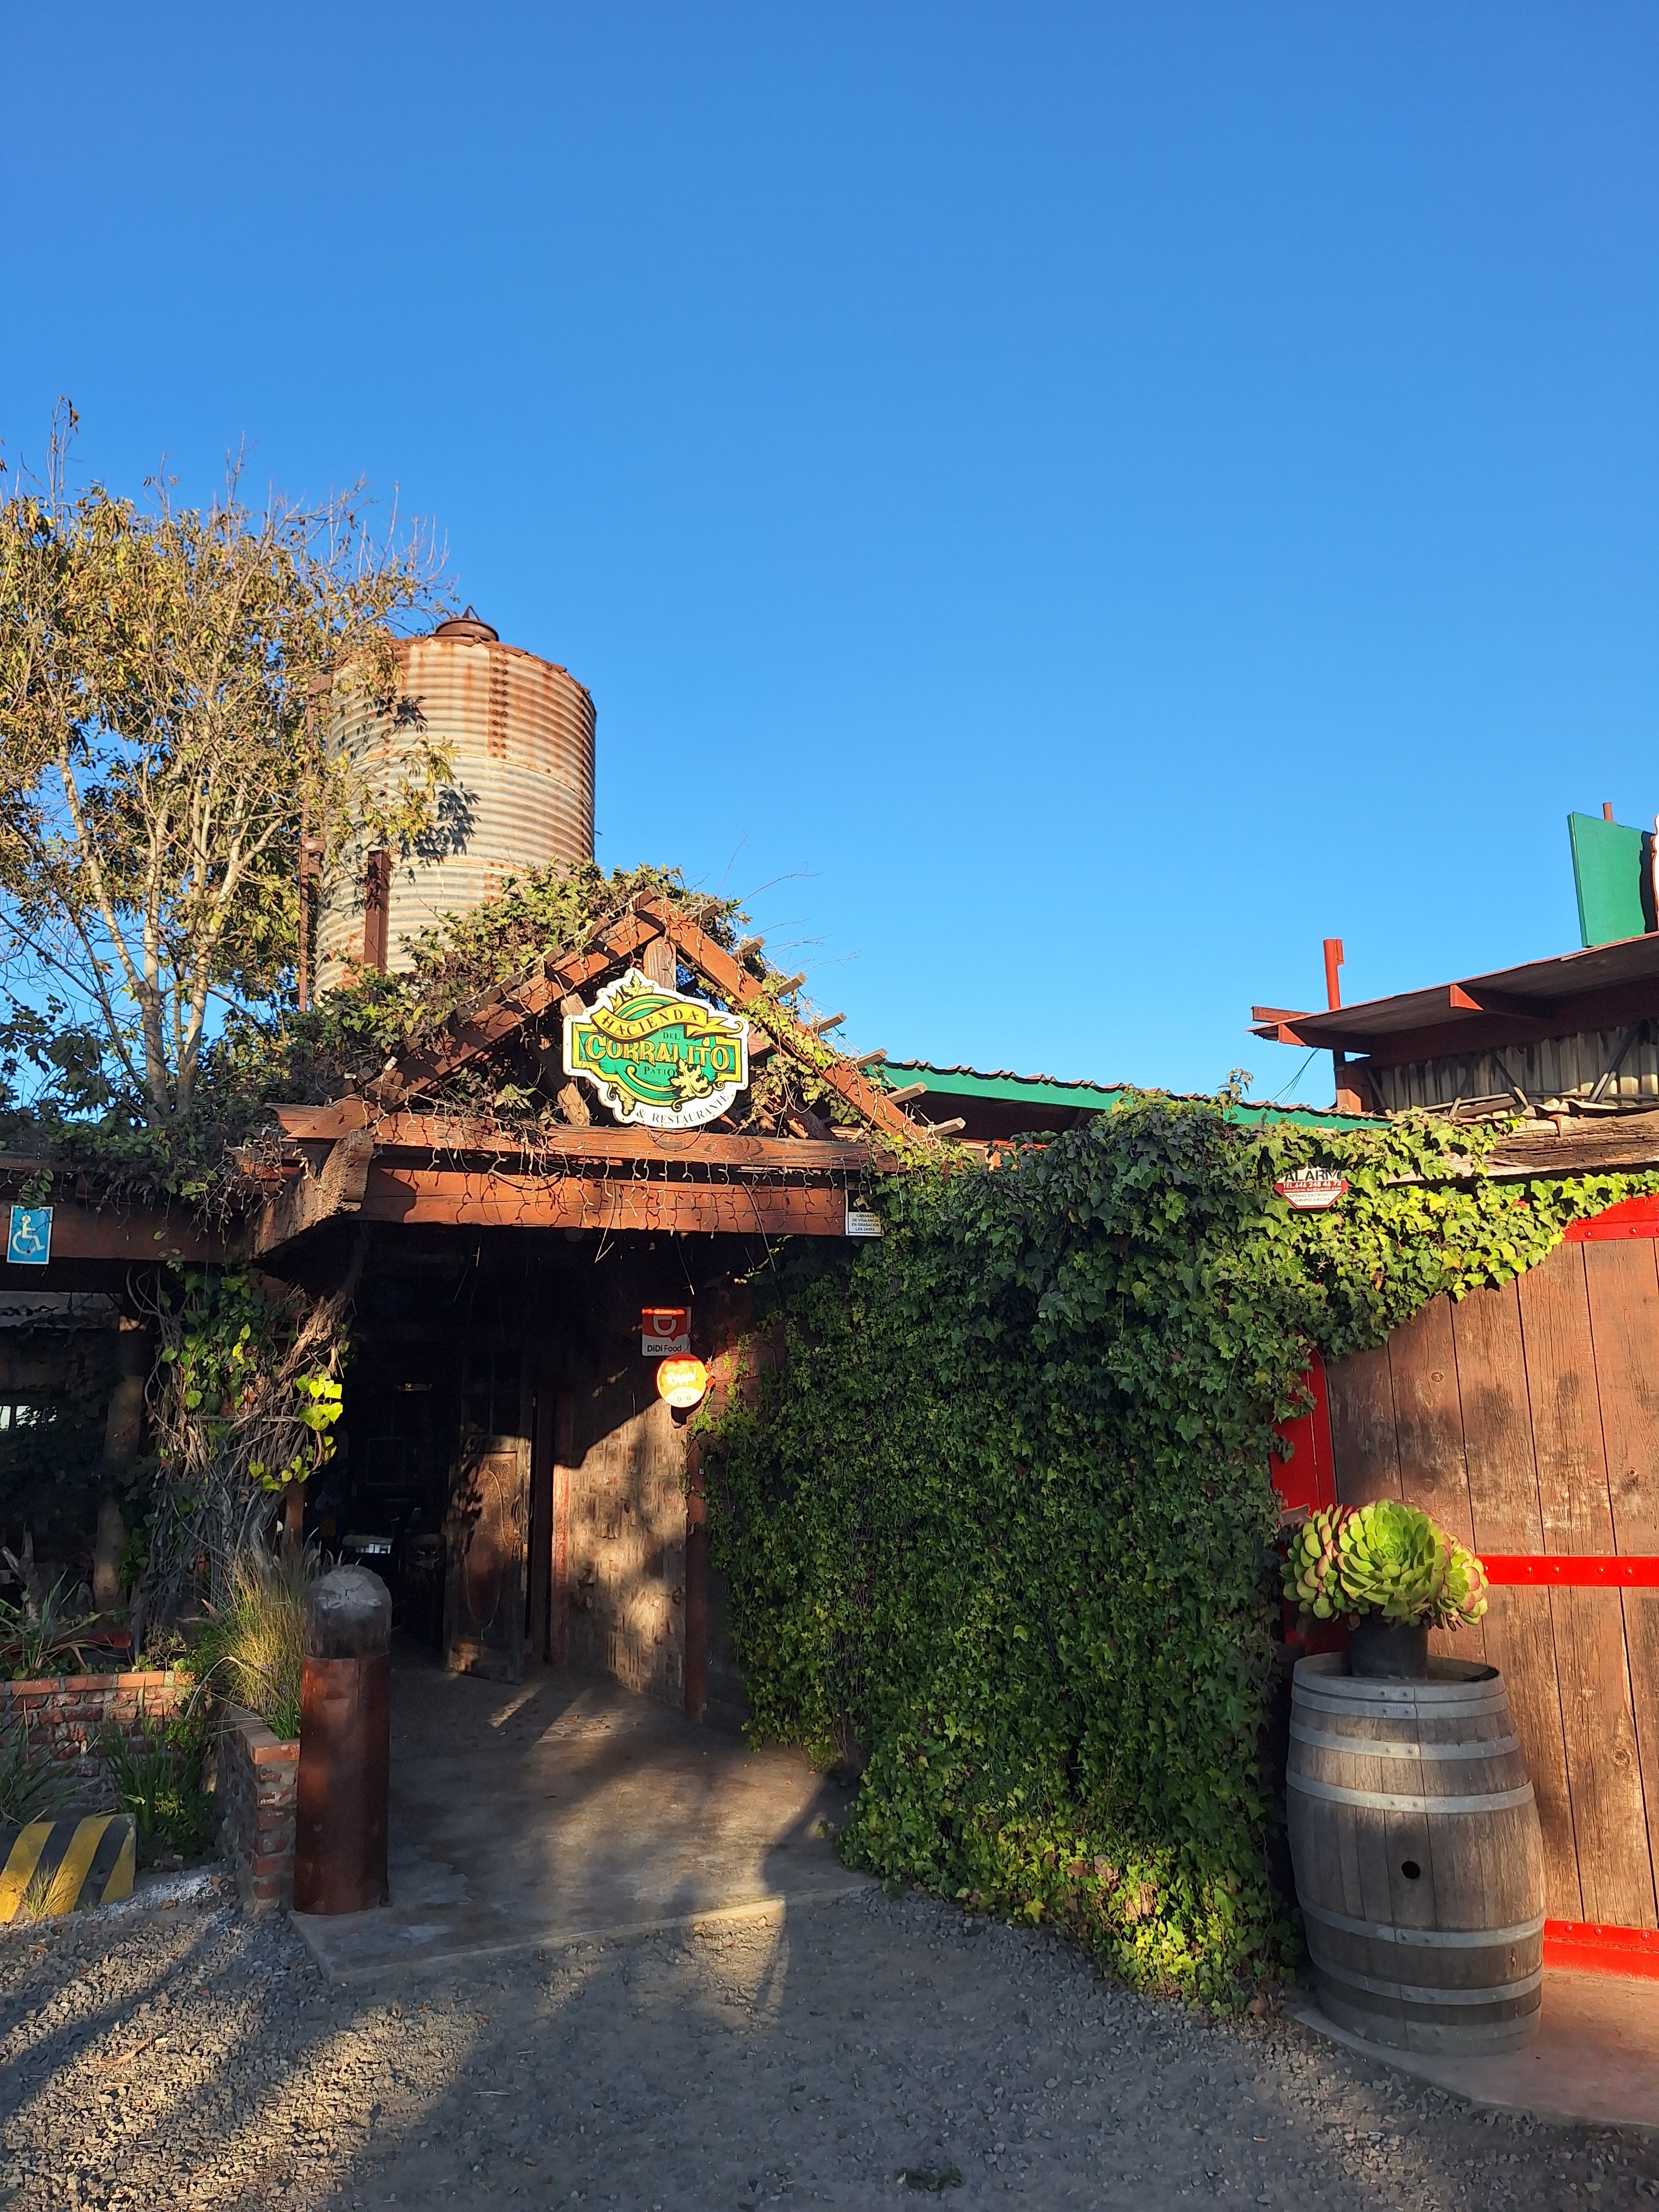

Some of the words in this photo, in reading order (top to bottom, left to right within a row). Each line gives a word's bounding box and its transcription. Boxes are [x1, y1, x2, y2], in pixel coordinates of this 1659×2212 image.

[601, 1009, 699, 1036] HACIENDA
[585, 1034, 730, 1071] CORRALITO
[636, 1109, 646, 1118] &
[652, 1092, 729, 1124] RESTAURANTE
